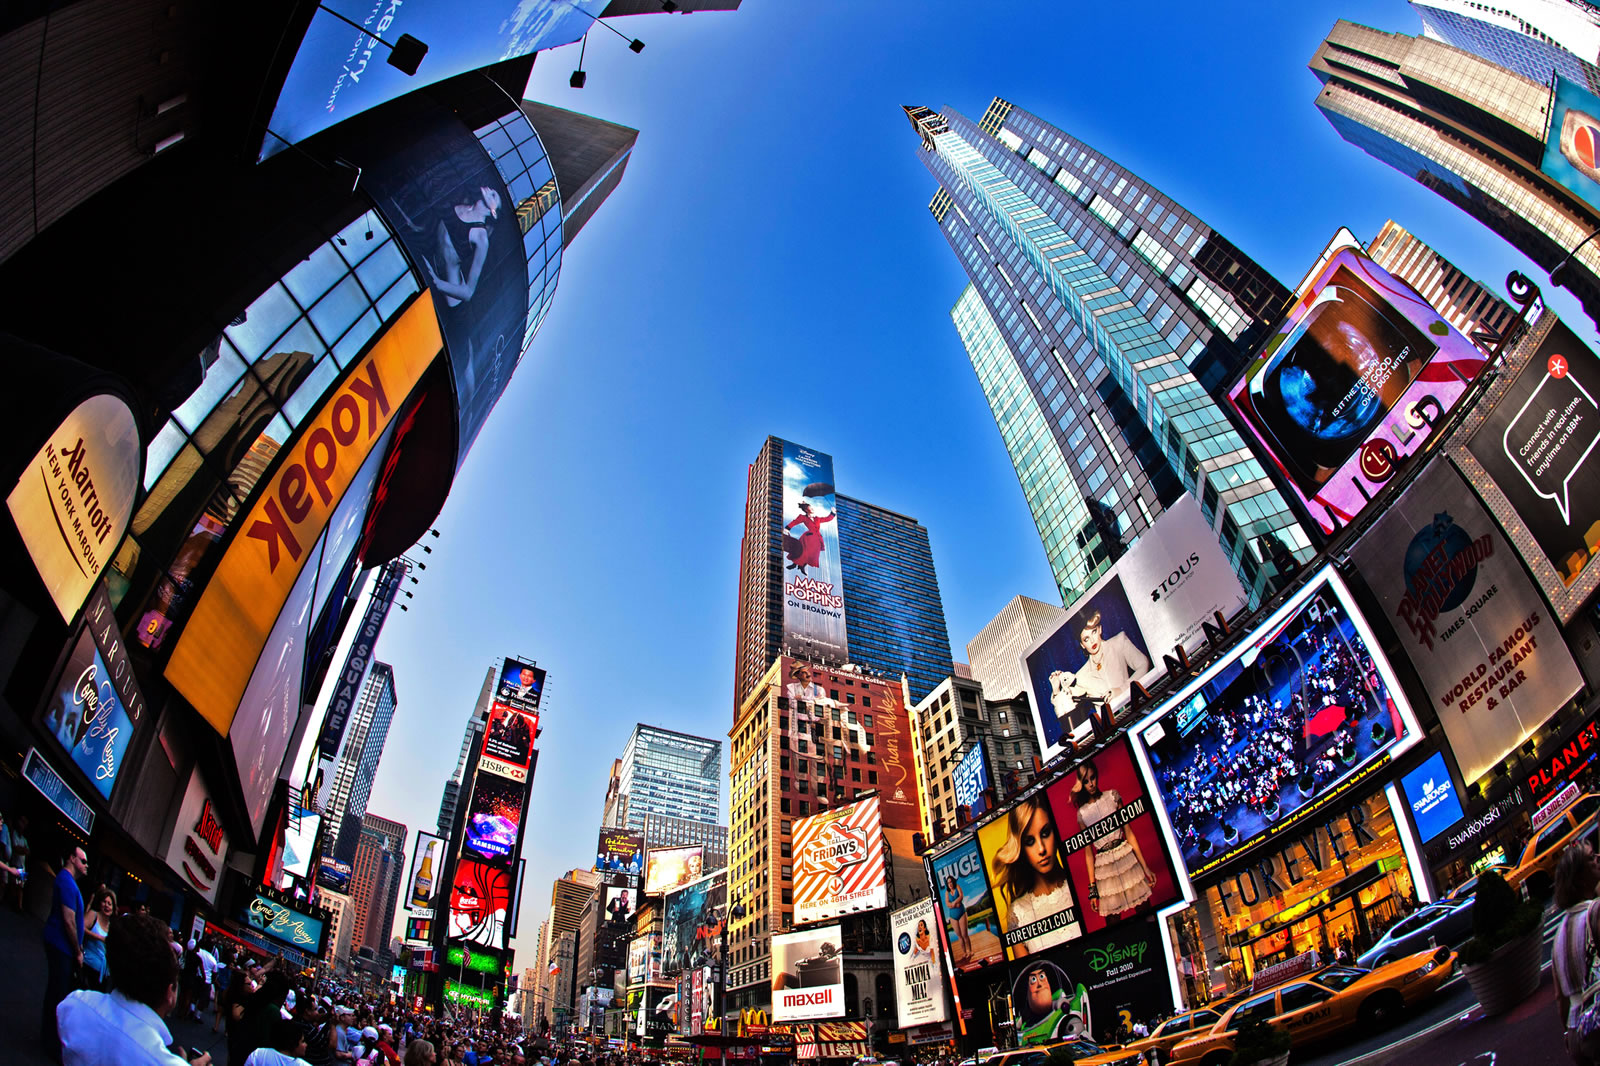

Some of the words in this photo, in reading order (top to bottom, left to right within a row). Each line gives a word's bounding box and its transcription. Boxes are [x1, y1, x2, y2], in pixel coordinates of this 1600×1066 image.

[1331, 408, 1340, 417] IS
[1338, 400, 1346, 410] IT
[1343, 389, 1358, 403] THE
[1353, 359, 1380, 389] TRIUMPH
[1360, 381, 1371, 395] OF
[1370, 356, 1392, 383] GOOD
[1361, 386, 1378, 407] OVER
[1376, 368, 1393, 389] DUST
[1390, 345, 1411, 371] MITES?
[1519, 424, 1545, 456] Connect
[1543, 408, 1557, 426] with
[1527, 438, 1550, 467] friends
[1546, 430, 1556, 440] in
[1553, 396, 1582, 432] real-time,
[1535, 443, 1561, 476] anytime
[1559, 432, 1569, 445] on
[1565, 414, 1583, 435] BBM.
[246, 359, 391, 574] Kodak
[45, 443, 61, 478] NEW
[58, 478, 76, 520] YORK
[72, 517, 100, 575] MARQUIS
[61, 438, 112, 544] Marriott
[795, 575, 834, 595] MARY
[1158, 552, 1200, 594] TOUS
[1397, 540, 1454, 632] PLANET
[1414, 533, 1495, 651] HOLLYWOOD
[786, 582, 843, 608] POPPINS
[788, 600, 800, 608] ON
[802, 604, 842, 619] BROADWAY
[1440, 617, 1465, 643] TIMES
[1465, 584, 1499, 620] SQUARE
[91, 598, 143, 720] MARQUIS
[813, 663, 829, 672] 100%
[830, 668, 865, 681] Colombian
[1441, 663, 1487, 707] WORLD
[1488, 611, 1541, 665] FAMOUS
[1458, 636, 1539, 714] RESTAURANT
[73, 664, 98, 711] Come
[330, 643, 368, 730] SQUARE
[1486, 695, 1500, 711] &
[1498, 669, 1527, 701] BAR
[84, 680, 115, 738] Fly
[877, 687, 900, 736] Valdez
[95, 727, 120, 780] Away
[481, 759, 510, 775] HSBC
[881, 734, 907, 786] Juan
[952, 743, 981, 780] WINNER!
[1528, 721, 1598, 794] PLANET
[956, 765, 982, 806] BEST
[1277, 818, 1292, 829] proud
[1298, 806, 1313, 816] where
[1313, 800, 1323, 808] you
[1323, 792, 1336, 800] come
[1366, 759, 1383, 772] happy
[1413, 779, 1451, 812] SWAROVSKI
[1546, 796, 1562, 815] SIDE
[1560, 785, 1577, 805] STORY
[472, 839, 506, 855] SAMSUNG
[605, 837, 638, 848] Addams
[1065, 799, 1145, 853] FOREVER21.COM
[1449, 807, 1501, 849] SWAROVSKI
[608, 844, 636, 857] Family
[937, 851, 980, 887] HUGE
[1217, 803, 1383, 917] FOREVER
[800, 902, 817, 910] HERE
[831, 894, 848, 903] 46TH
[849, 888, 874, 900] STREET
[902, 906, 919, 920] WORLD'S
[919, 901, 932, 910] MOST
[250, 898, 274, 916] Come
[265, 903, 291, 926] Fly
[287, 921, 316, 944] Away
[895, 915, 913, 926] POPULAR
[1006, 909, 1075, 945] FOREVER21.COM
[904, 964, 931, 986] MAMMA
[1106, 968, 1119, 977] Fall
[1119, 962, 1134, 973] 2010
[1115, 974, 1128, 982] Retail
[1128, 967, 1152, 979] Experience
[1254, 953, 1306, 979] FLASHDANCERS
[783, 988, 832, 1007] maxell
[911, 982, 928, 1001] MIA!
[1302, 1007, 1331, 1025] TAXI
